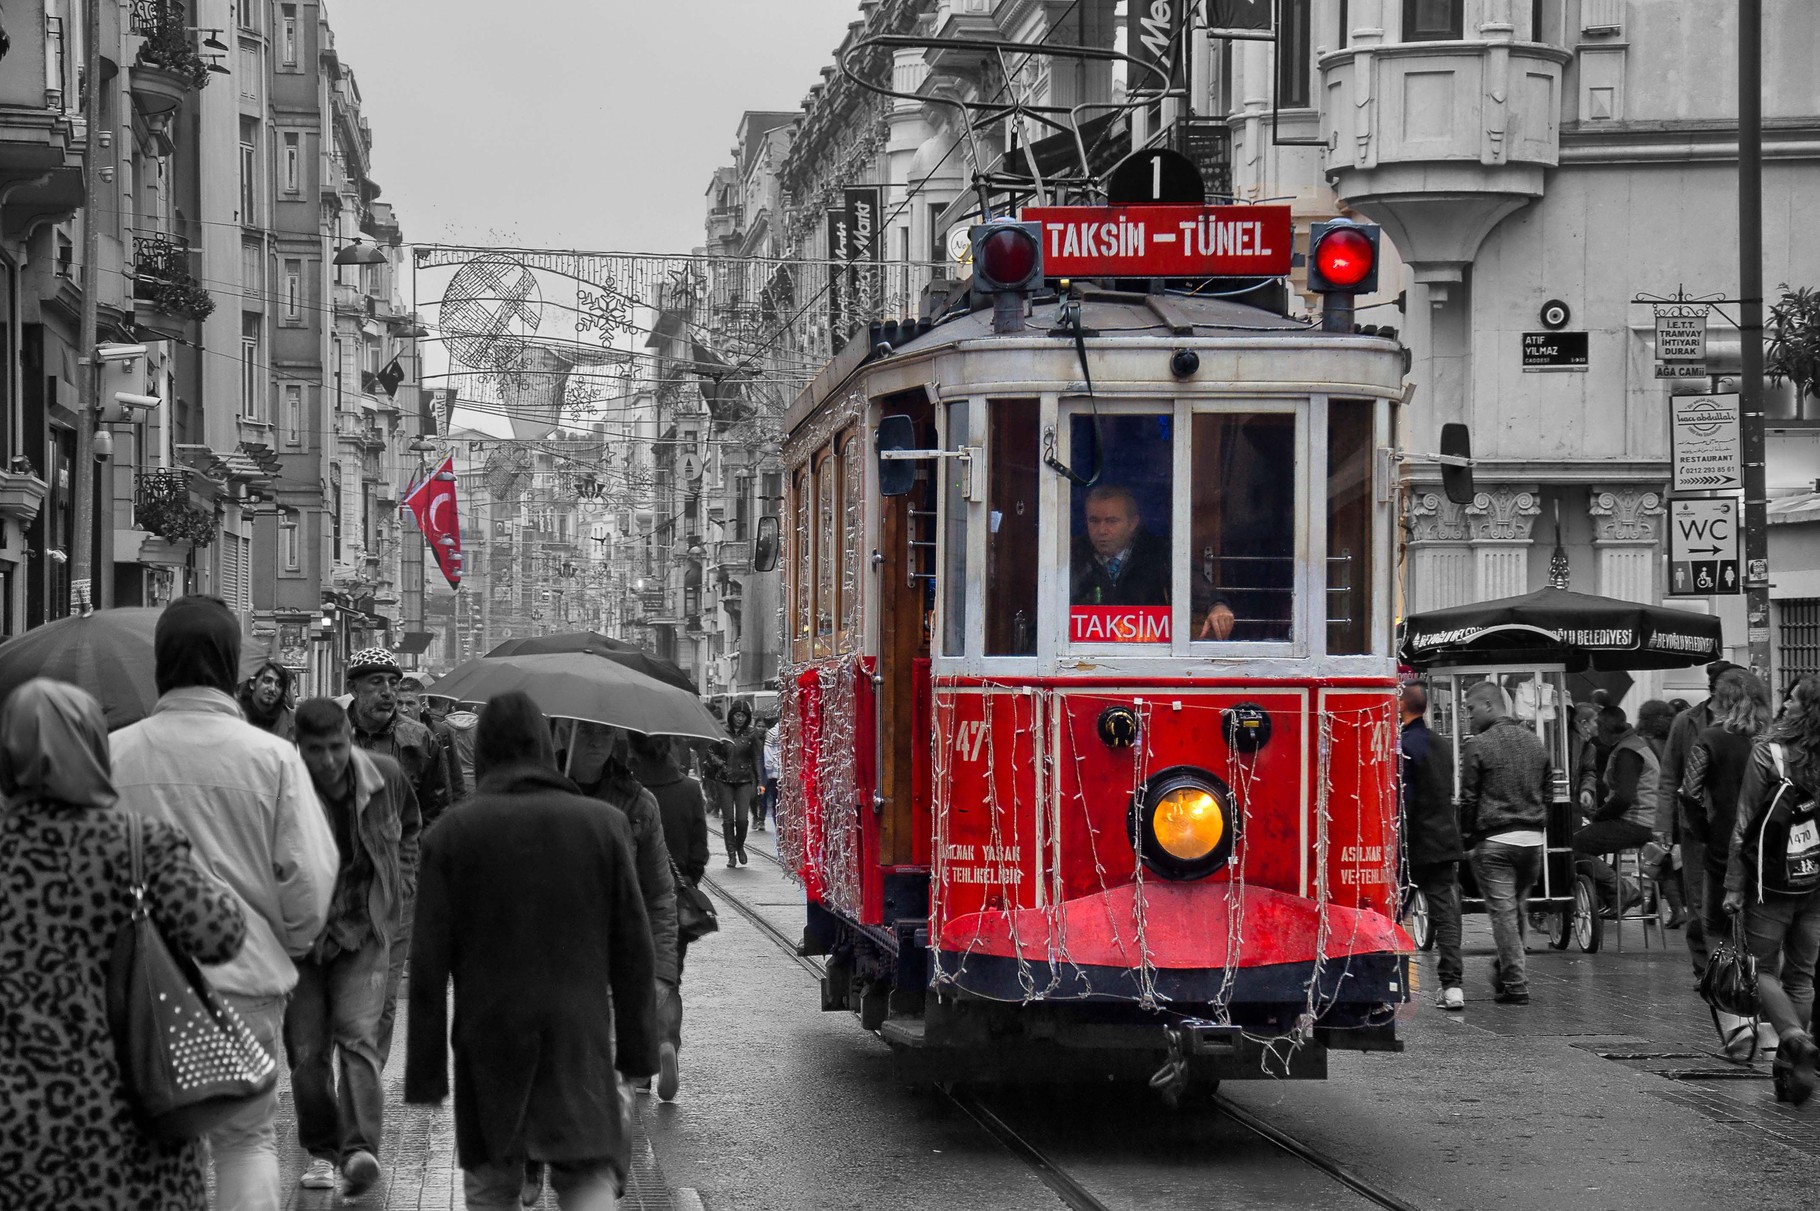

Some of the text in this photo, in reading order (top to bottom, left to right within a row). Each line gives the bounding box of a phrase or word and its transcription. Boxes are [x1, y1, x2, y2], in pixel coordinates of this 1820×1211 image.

[1140, 0, 1171, 68] Me
[1150, 156, 1161, 199] 1
[853, 201, 870, 261] Markt
[1047, 215, 1145, 257] TAKSİM
[1180, 215, 1272, 257] TÜNEL
[1525, 336, 1545, 345] ATIF
[1659, 330, 1702, 338] TRAMVAY
[1525, 346, 1558, 356] YILMAZ
[1665, 347, 1697, 355] DURAK
[1657, 366, 1677, 377] AĞA
[436, 394, 446, 419] TIME
[1680, 454, 1734, 463] RESTAURANT
[1678, 518, 1728, 541] WC
[1071, 610, 1170, 638] TAKSİM
[955, 720, 987, 762] 47
[1340, 869, 1356, 885] VE
